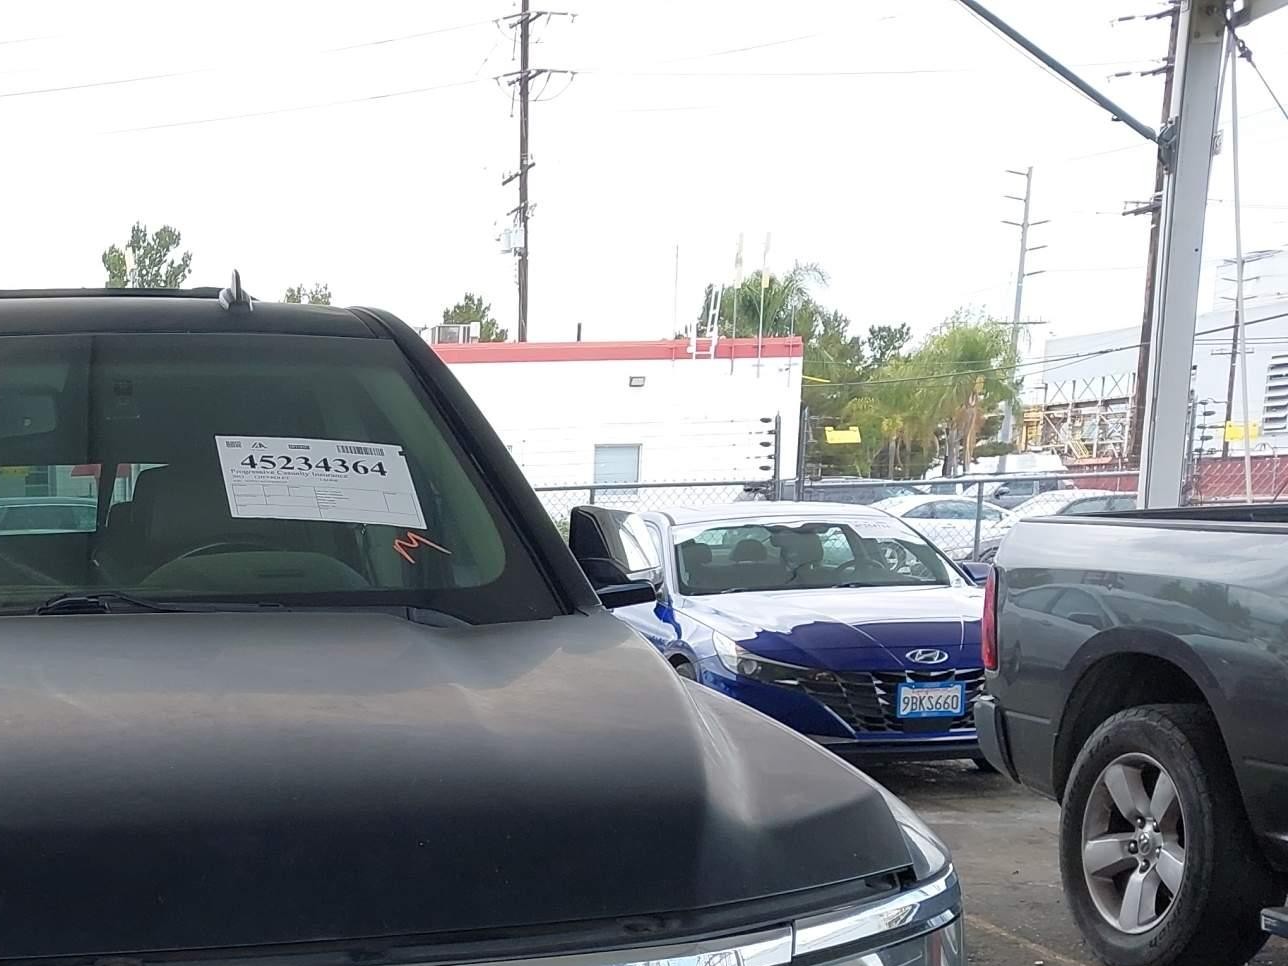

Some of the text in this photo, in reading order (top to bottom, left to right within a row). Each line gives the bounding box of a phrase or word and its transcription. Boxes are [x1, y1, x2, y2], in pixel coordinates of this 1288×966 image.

[230, 468, 349, 479] Progressive Casualty Insurance
[240, 454, 387, 476] 45234364
[902, 694, 959, 712] 9BKS660
